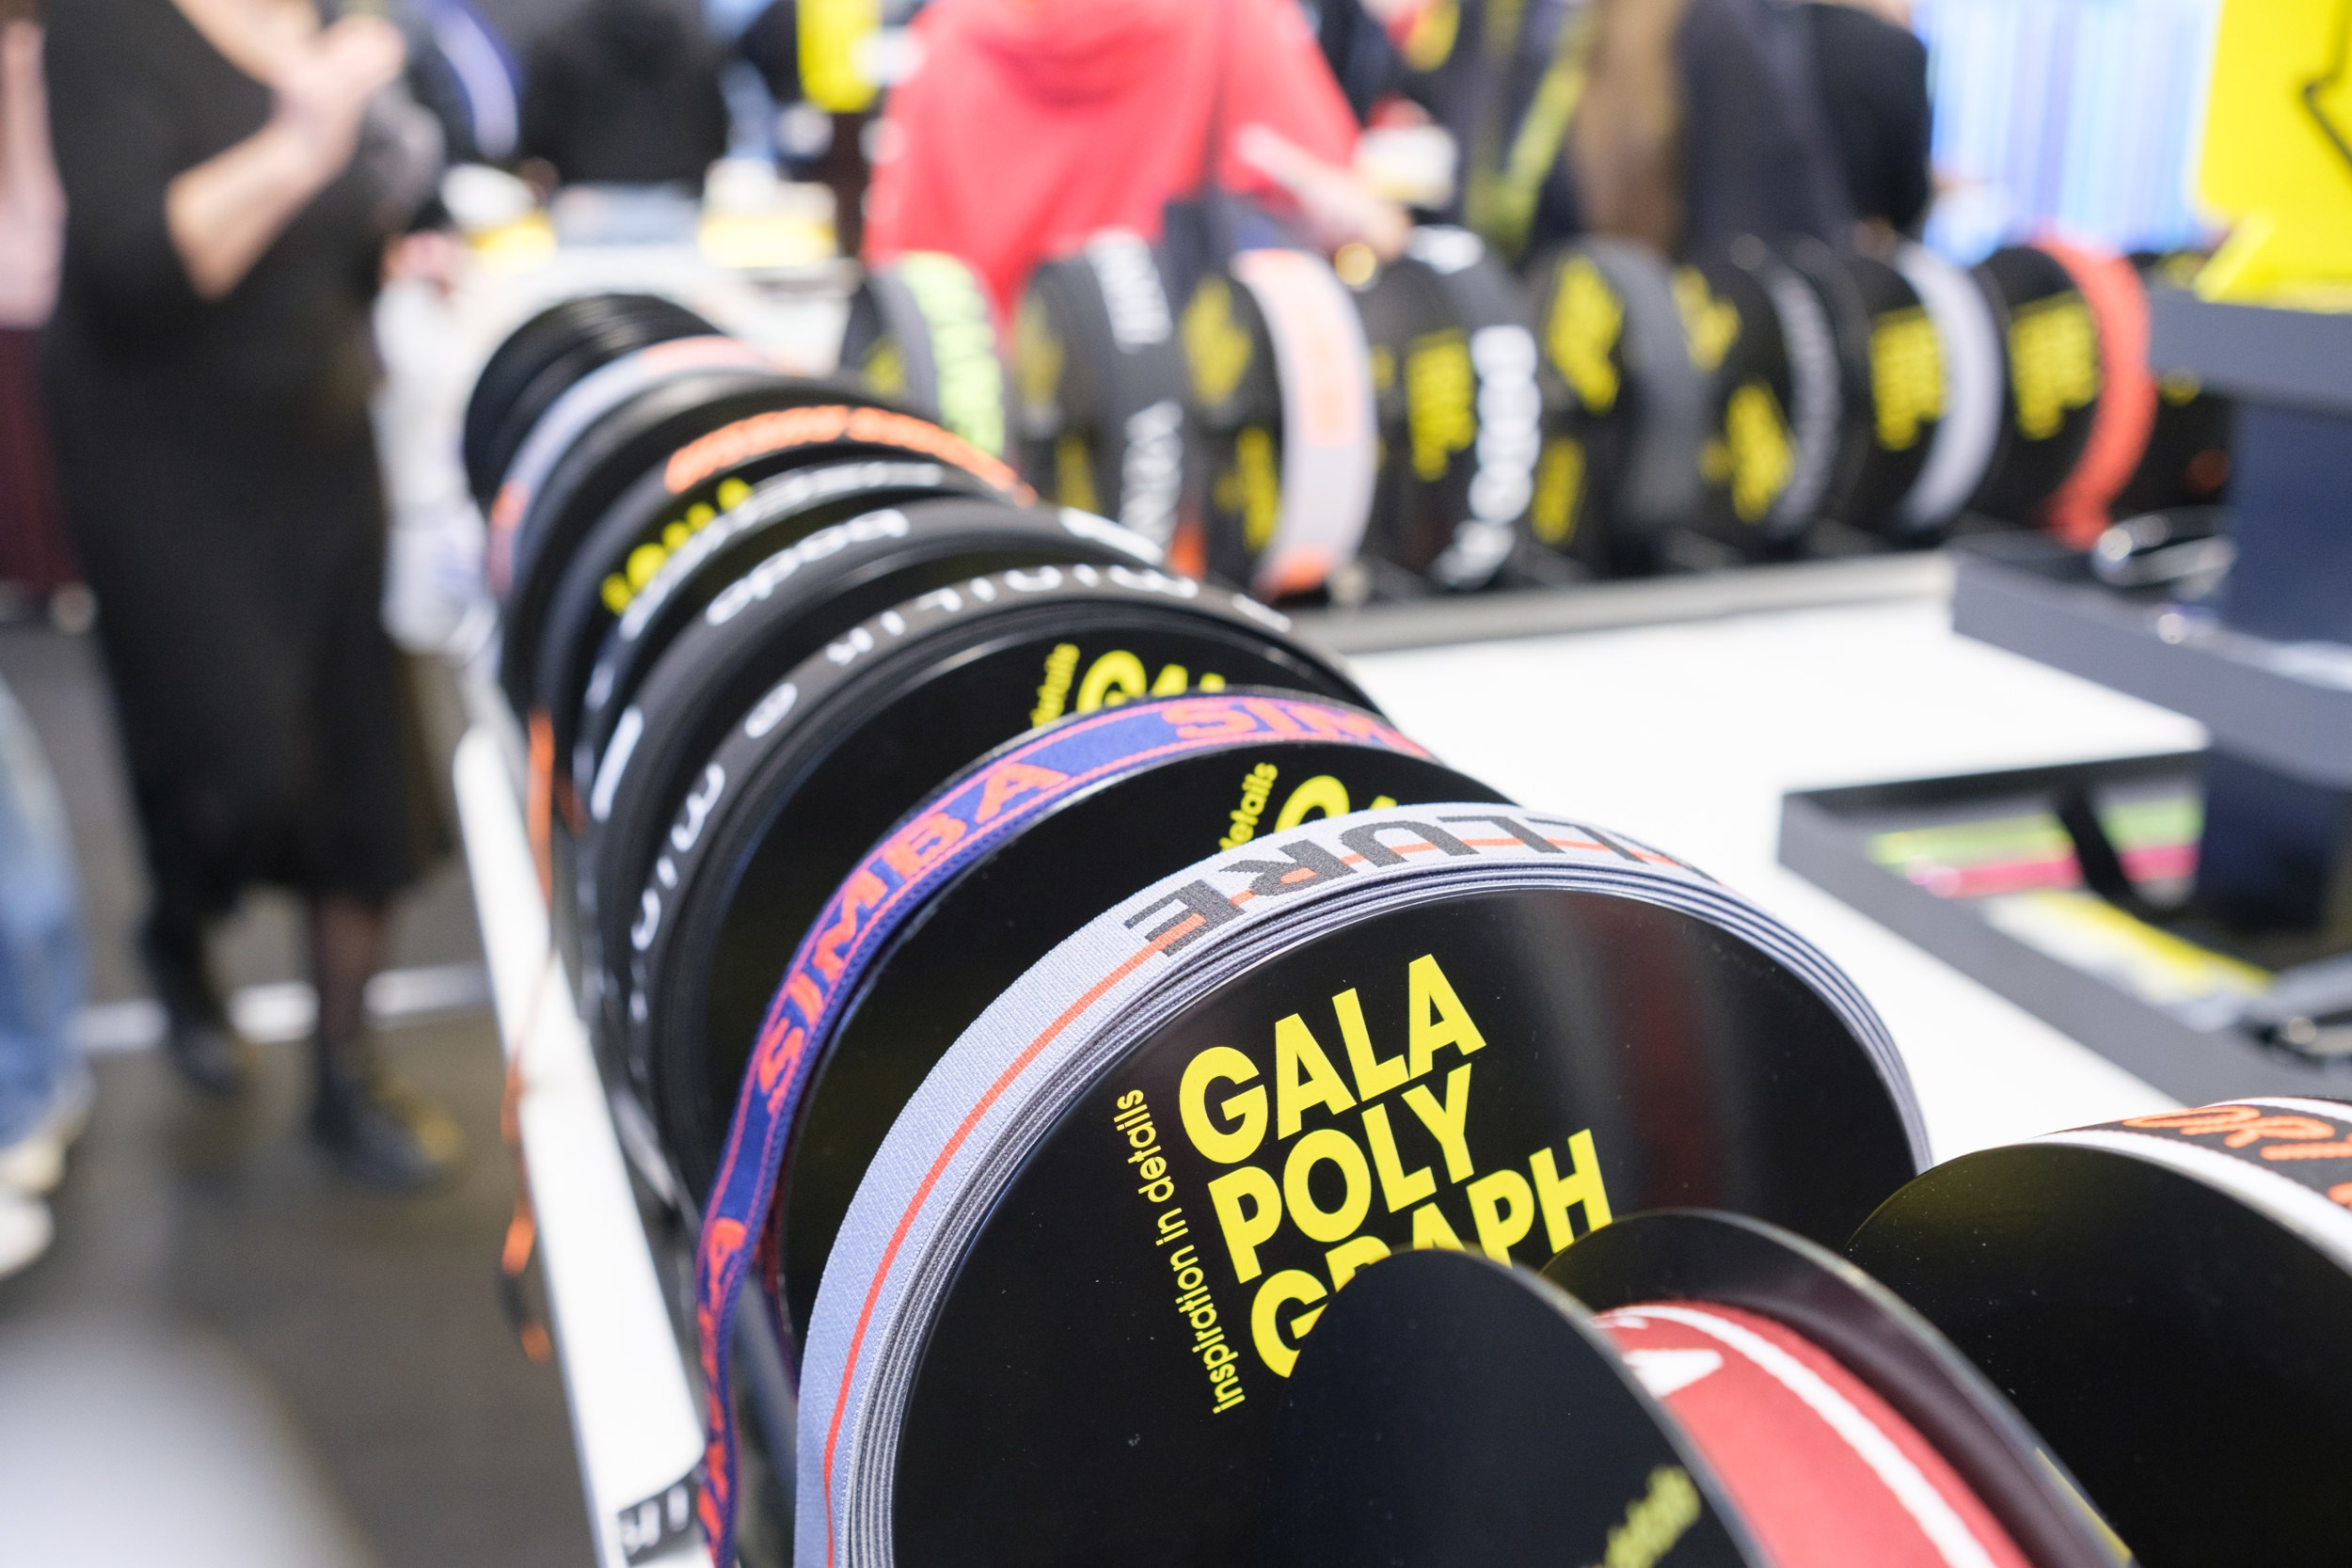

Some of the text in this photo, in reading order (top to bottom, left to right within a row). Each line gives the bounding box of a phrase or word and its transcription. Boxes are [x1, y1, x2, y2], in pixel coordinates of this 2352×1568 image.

[757, 762, 1070, 1115] SIMBA
[1179, 954, 1486, 1164] GALA
[1113, 1089, 1246, 1415] inspiration in details
[1208, 1063, 1474, 1284] POLY
